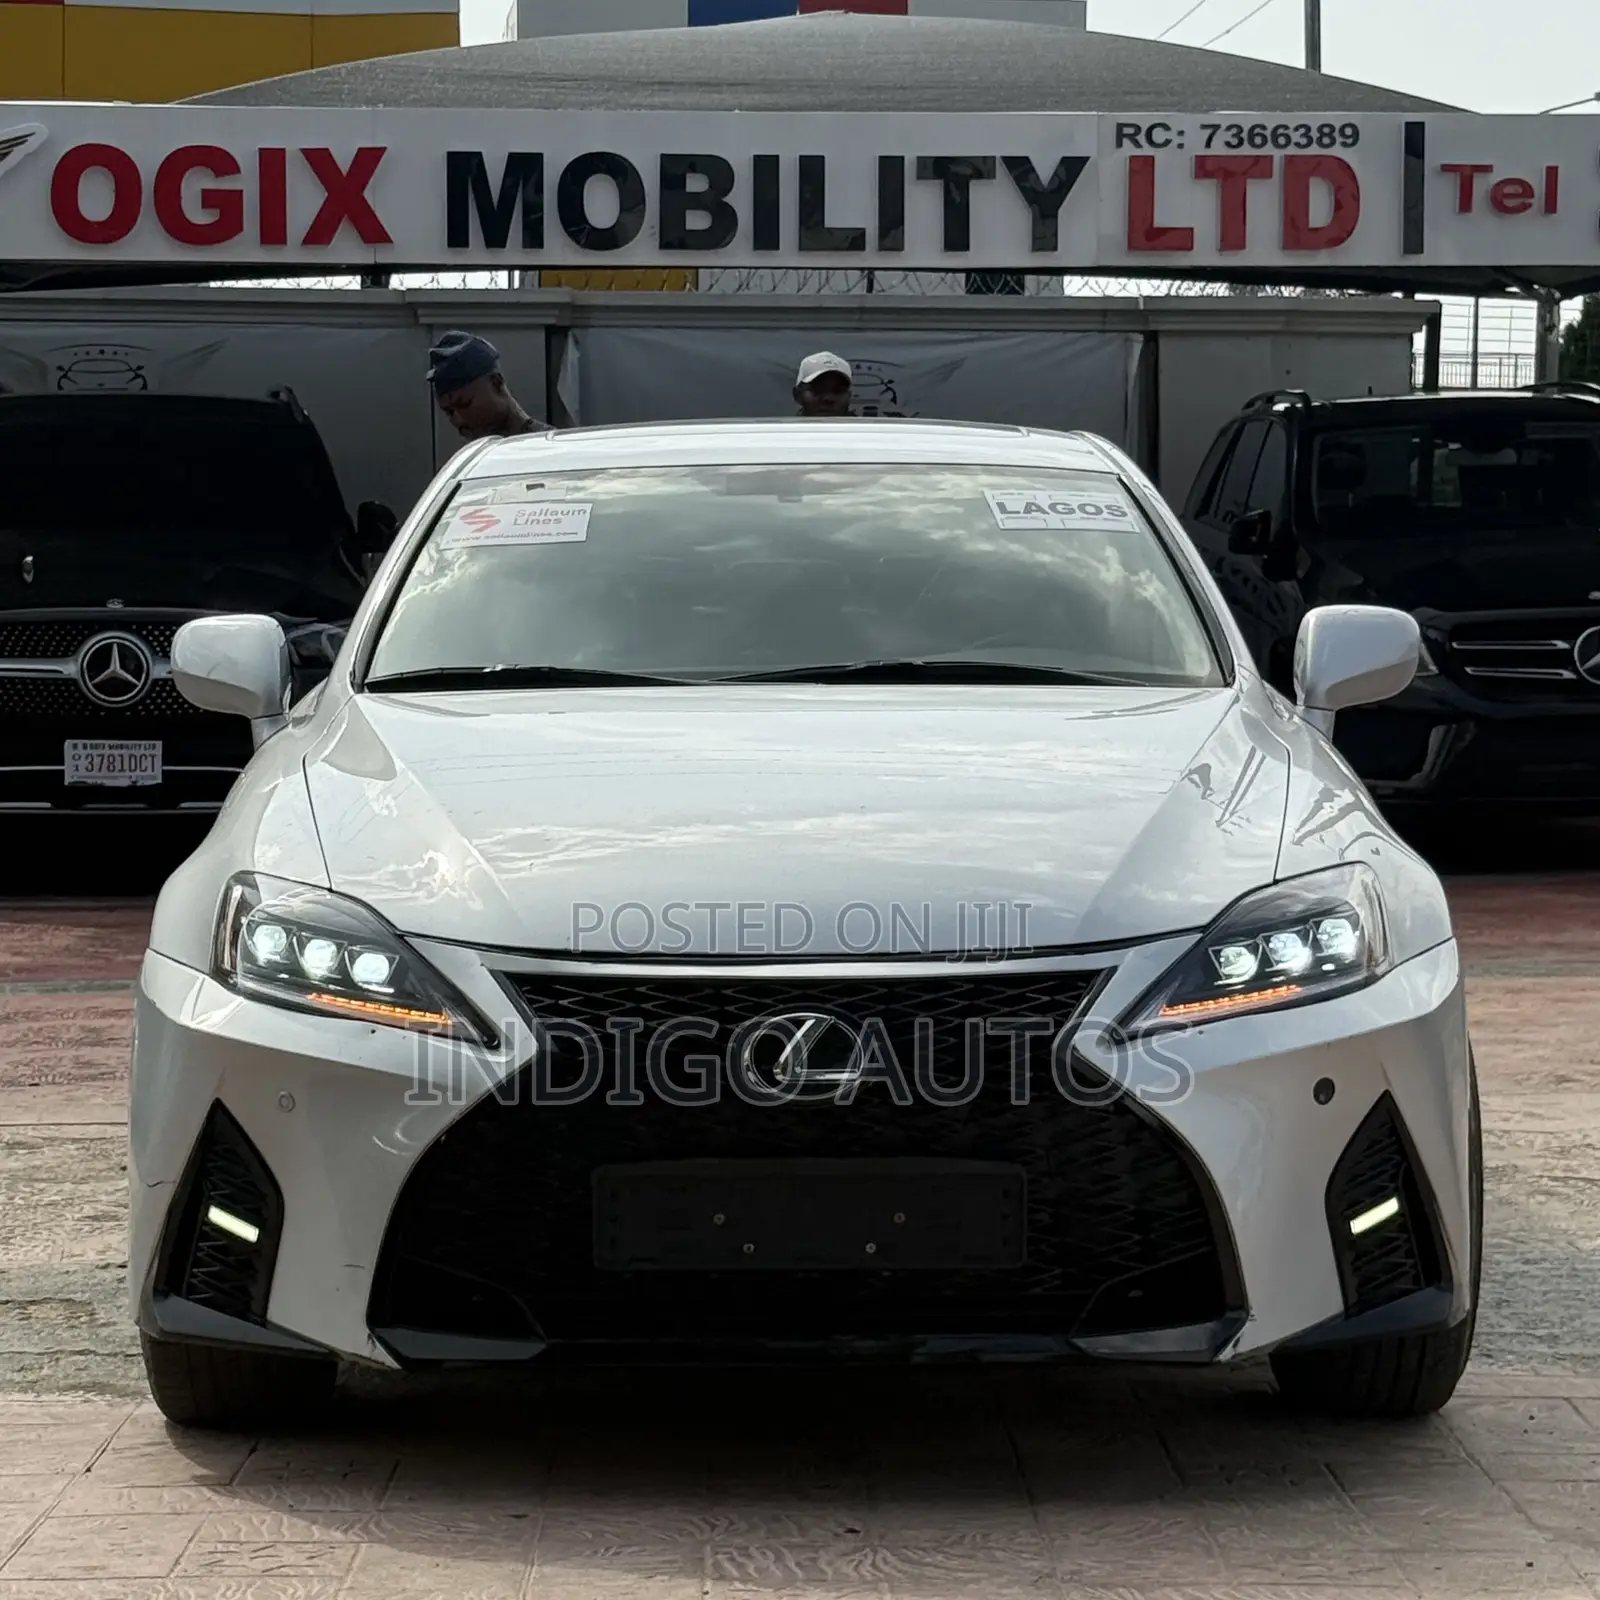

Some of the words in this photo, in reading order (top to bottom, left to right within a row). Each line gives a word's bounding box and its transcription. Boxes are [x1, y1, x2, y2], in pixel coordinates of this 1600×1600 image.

[1115, 122, 1186, 150] RC:
[1200, 122, 1360, 150] 7366389
[50, 142, 393, 247] OGIX
[446, 149, 1091, 252] MOBILITY
[1127, 154, 1361, 252] LTD
[1441, 163, 1559, 215] Tel
[996, 501, 1128, 517] LAGOS
[512, 515, 563, 526] Lines
